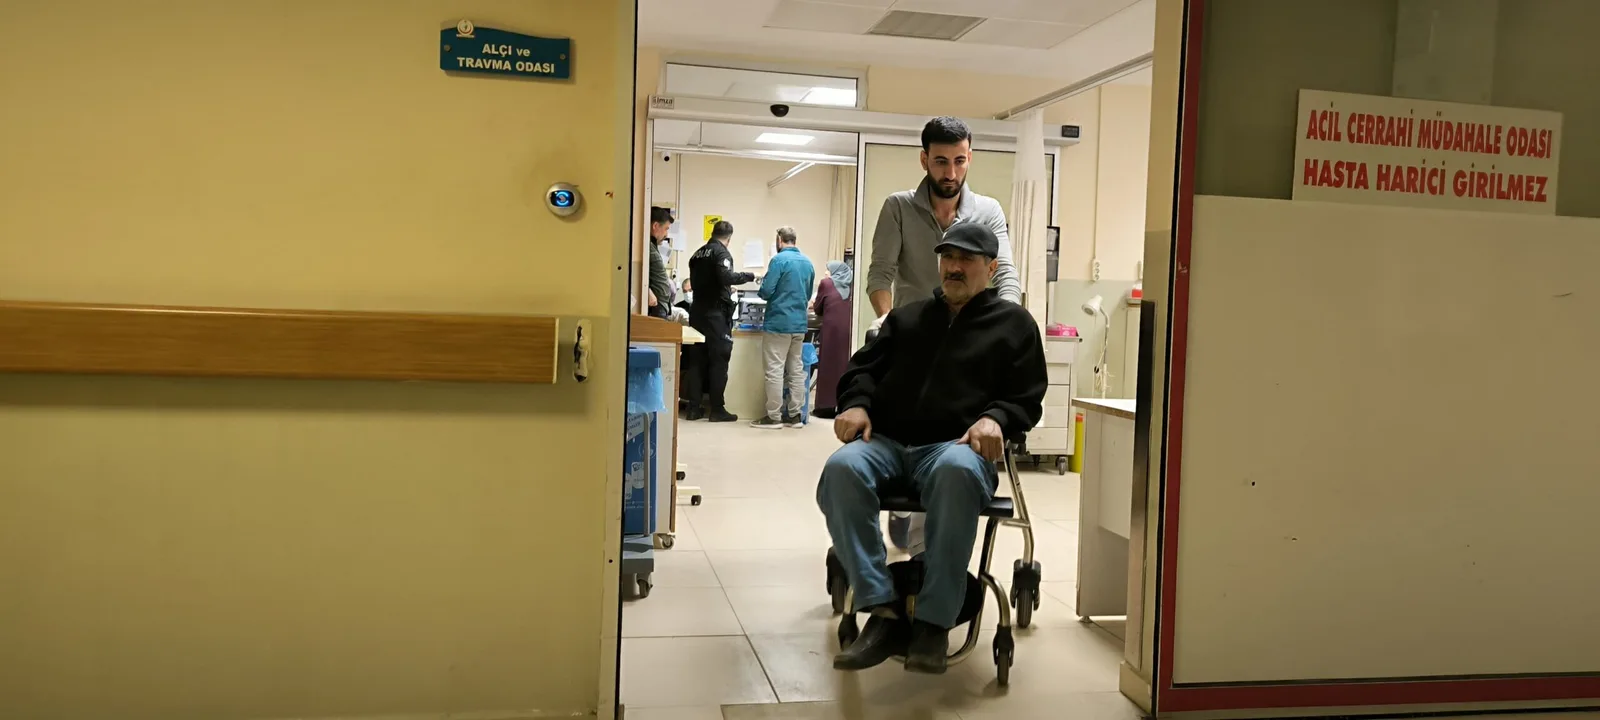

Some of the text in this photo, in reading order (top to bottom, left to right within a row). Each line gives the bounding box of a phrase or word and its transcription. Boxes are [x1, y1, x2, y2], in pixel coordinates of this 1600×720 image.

[457, 57, 555, 73] TRAVMA ODASI
[482, 43, 531, 57] ALÇI ve
[1306, 101, 1552, 158] ACİL CERRAHİ MÜDAHALE ODASI
[1303, 158, 1548, 202] HASTA HARİCİ GİRİLMEZ
